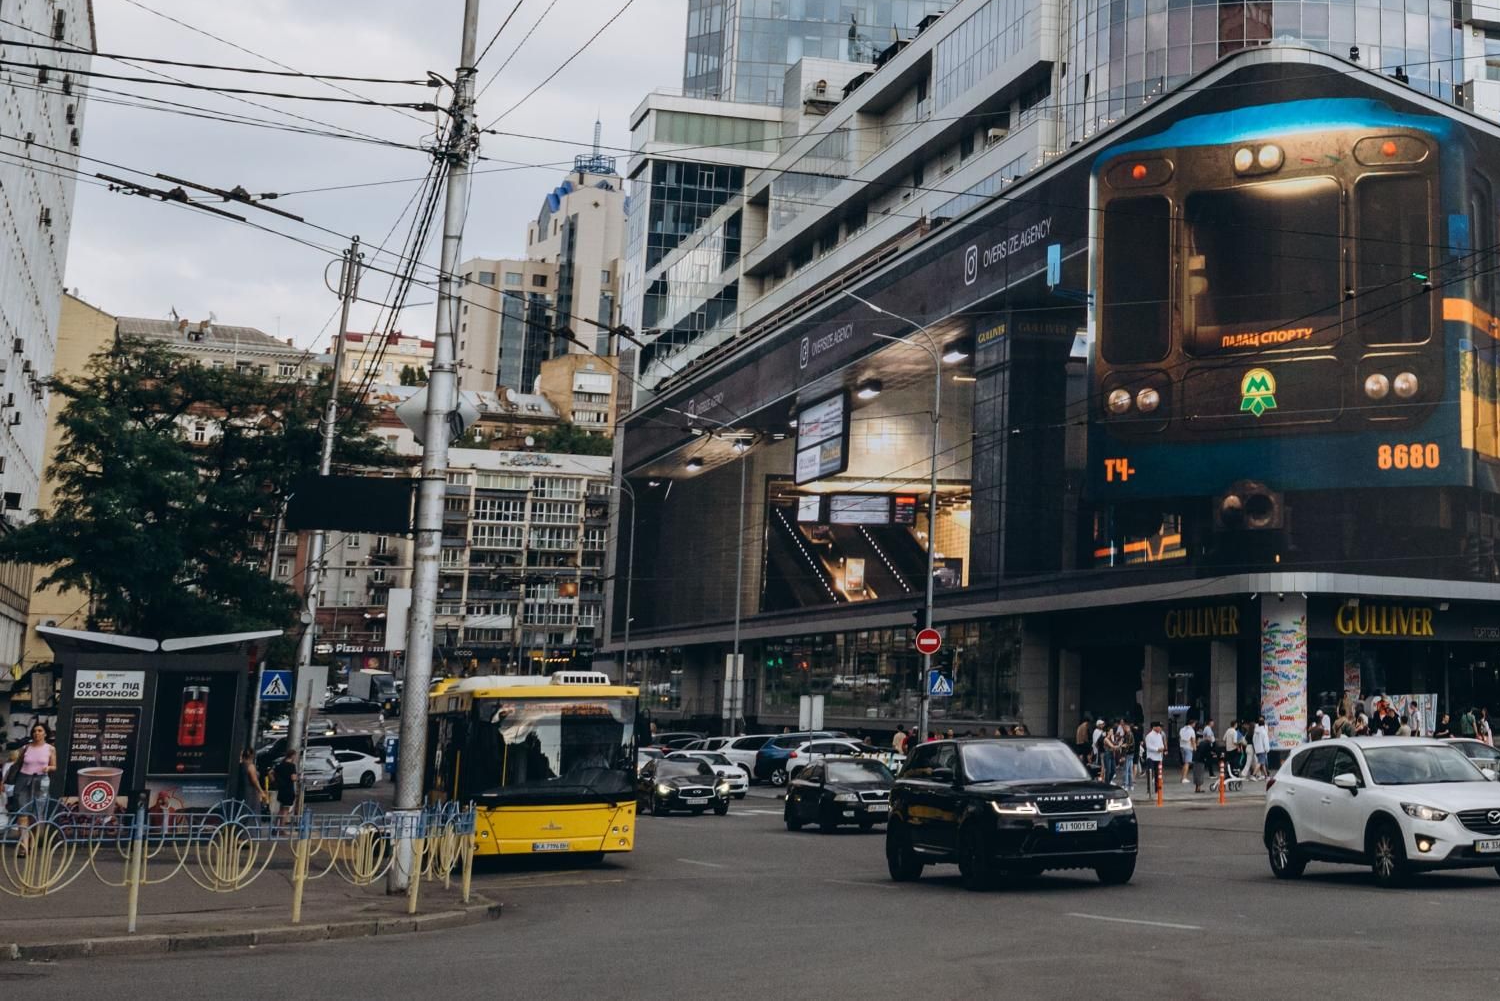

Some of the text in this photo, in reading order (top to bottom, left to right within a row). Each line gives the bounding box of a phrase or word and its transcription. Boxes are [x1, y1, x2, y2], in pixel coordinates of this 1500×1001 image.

[1222, 327, 1313, 348] ПАЛАЦ СПОРТУ
[1377, 443, 1440, 470] 8680
[1165, 605, 1239, 639] GULLIVER
[1336, 604, 1433, 636] GULLIVER
